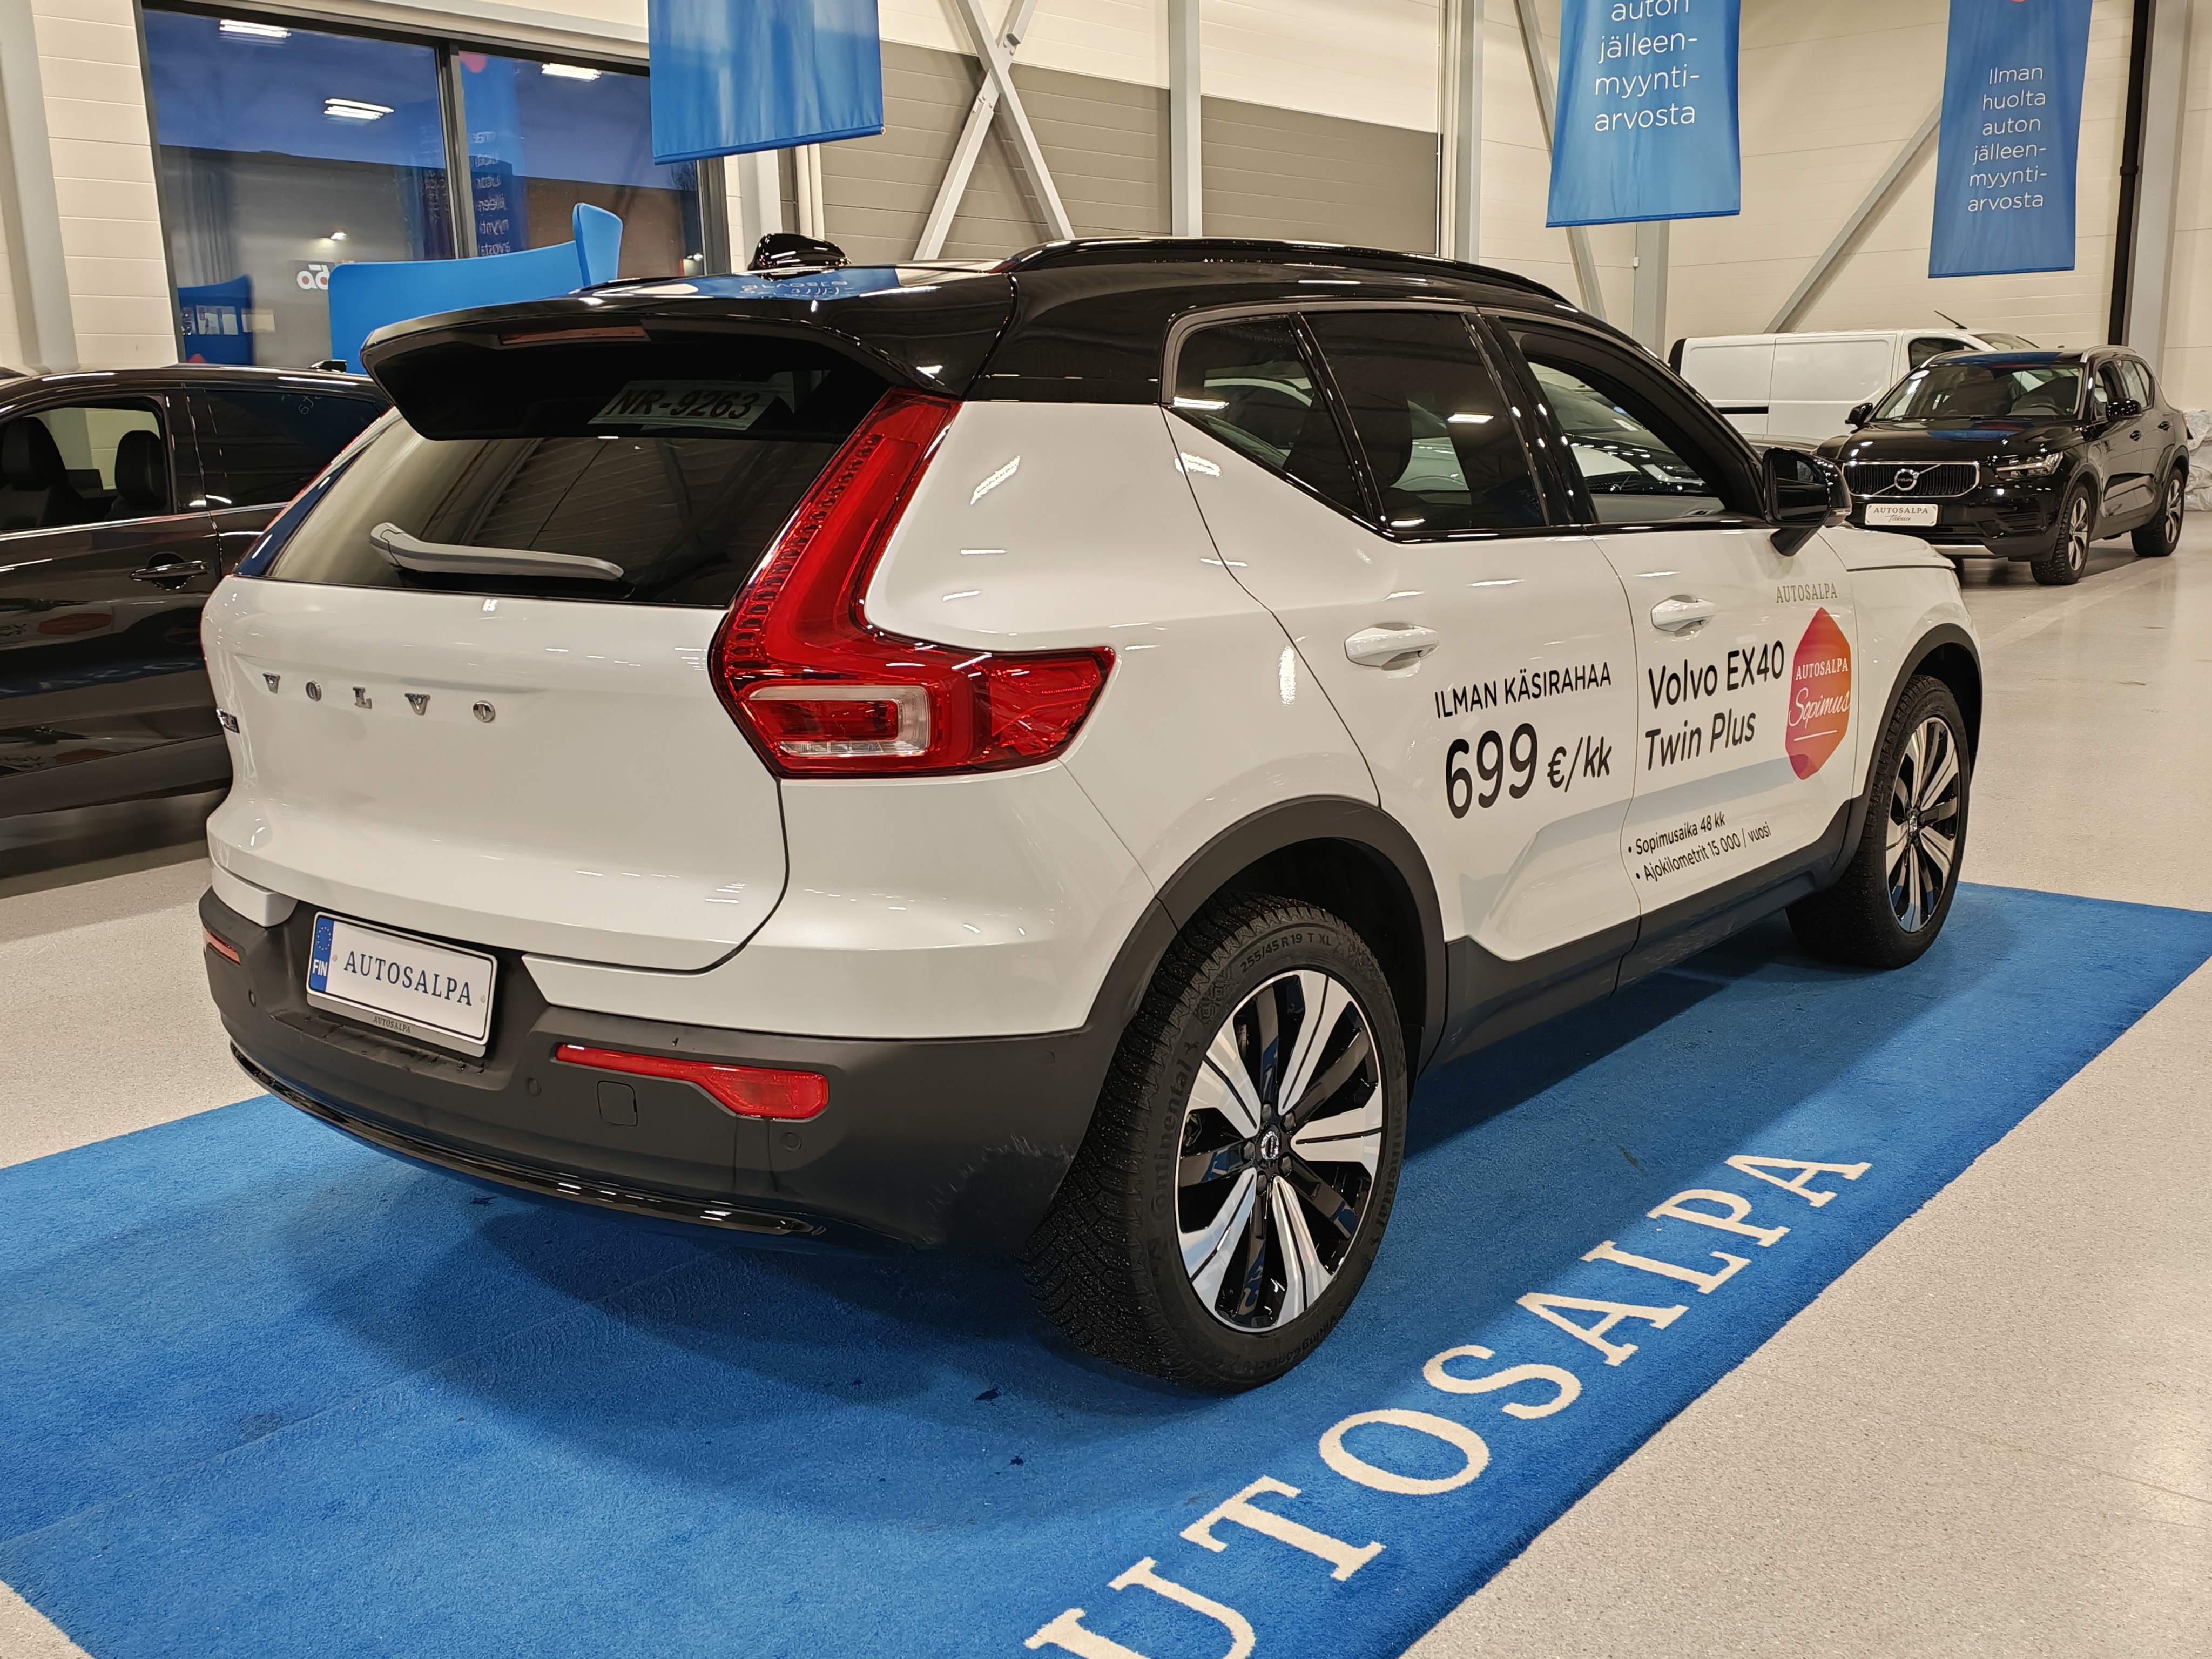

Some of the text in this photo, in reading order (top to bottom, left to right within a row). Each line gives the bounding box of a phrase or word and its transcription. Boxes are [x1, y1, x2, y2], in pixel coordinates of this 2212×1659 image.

[1611, 0, 1689, 21] auton
[1597, 32, 1698, 64] jälleen-
[1595, 64, 1700, 98] myynti-
[1989, 66, 2043, 85] Ilman
[1983, 89, 2046, 111] huolta
[1595, 103, 1695, 131] arvosta
[1982, 118, 2041, 136] auton
[1972, 143, 2047, 165] jälleen-
[1970, 165, 2047, 189] myynti-
[1968, 192, 2044, 212] arvosta
[605, 389, 760, 419] NR-9263
[1776, 582, 1838, 604] AUTOSALPA
[1648, 640, 1784, 709] Volvo EX40
[1795, 658, 1849, 681] AUTOSALPA
[262, 671, 496, 723] VOLVO
[1434, 662, 1611, 719] ILMAN KÄSIRAHAA
[1788, 687, 1850, 729] Sopimus
[1645, 707, 1756, 771] Twin Plus
[1445, 723, 1612, 819] 699 €/kk
[1635, 811, 1726, 855] Sopimusaika 48 kk
[1643, 845, 1709, 882] Ajokilometrit
[1747, 821, 1772, 842] vuosi
[312, 959, 328, 977] FIN
[343, 950, 473, 1007] AUTOSALPA
[372, 1016, 411, 1034] AUTOSALPA
